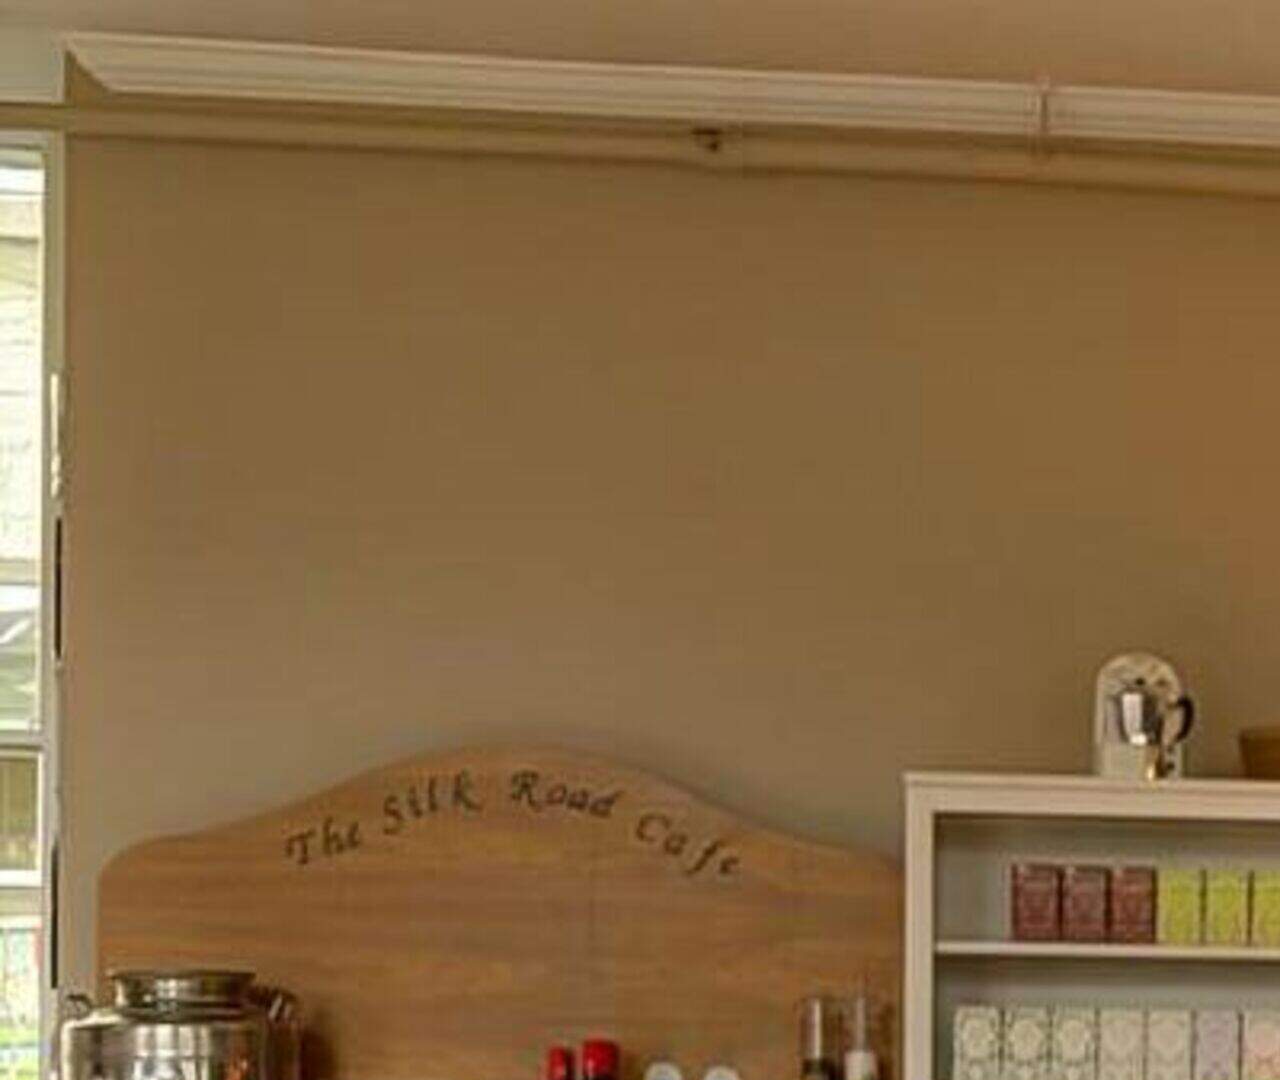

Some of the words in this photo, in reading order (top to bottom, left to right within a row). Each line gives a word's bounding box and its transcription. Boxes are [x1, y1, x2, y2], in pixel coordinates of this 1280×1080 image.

[285, 816, 362, 866] The
[383, 769, 484, 836] Silk
[509, 770, 620, 819] Road
[635, 812, 741, 877] Cafe
